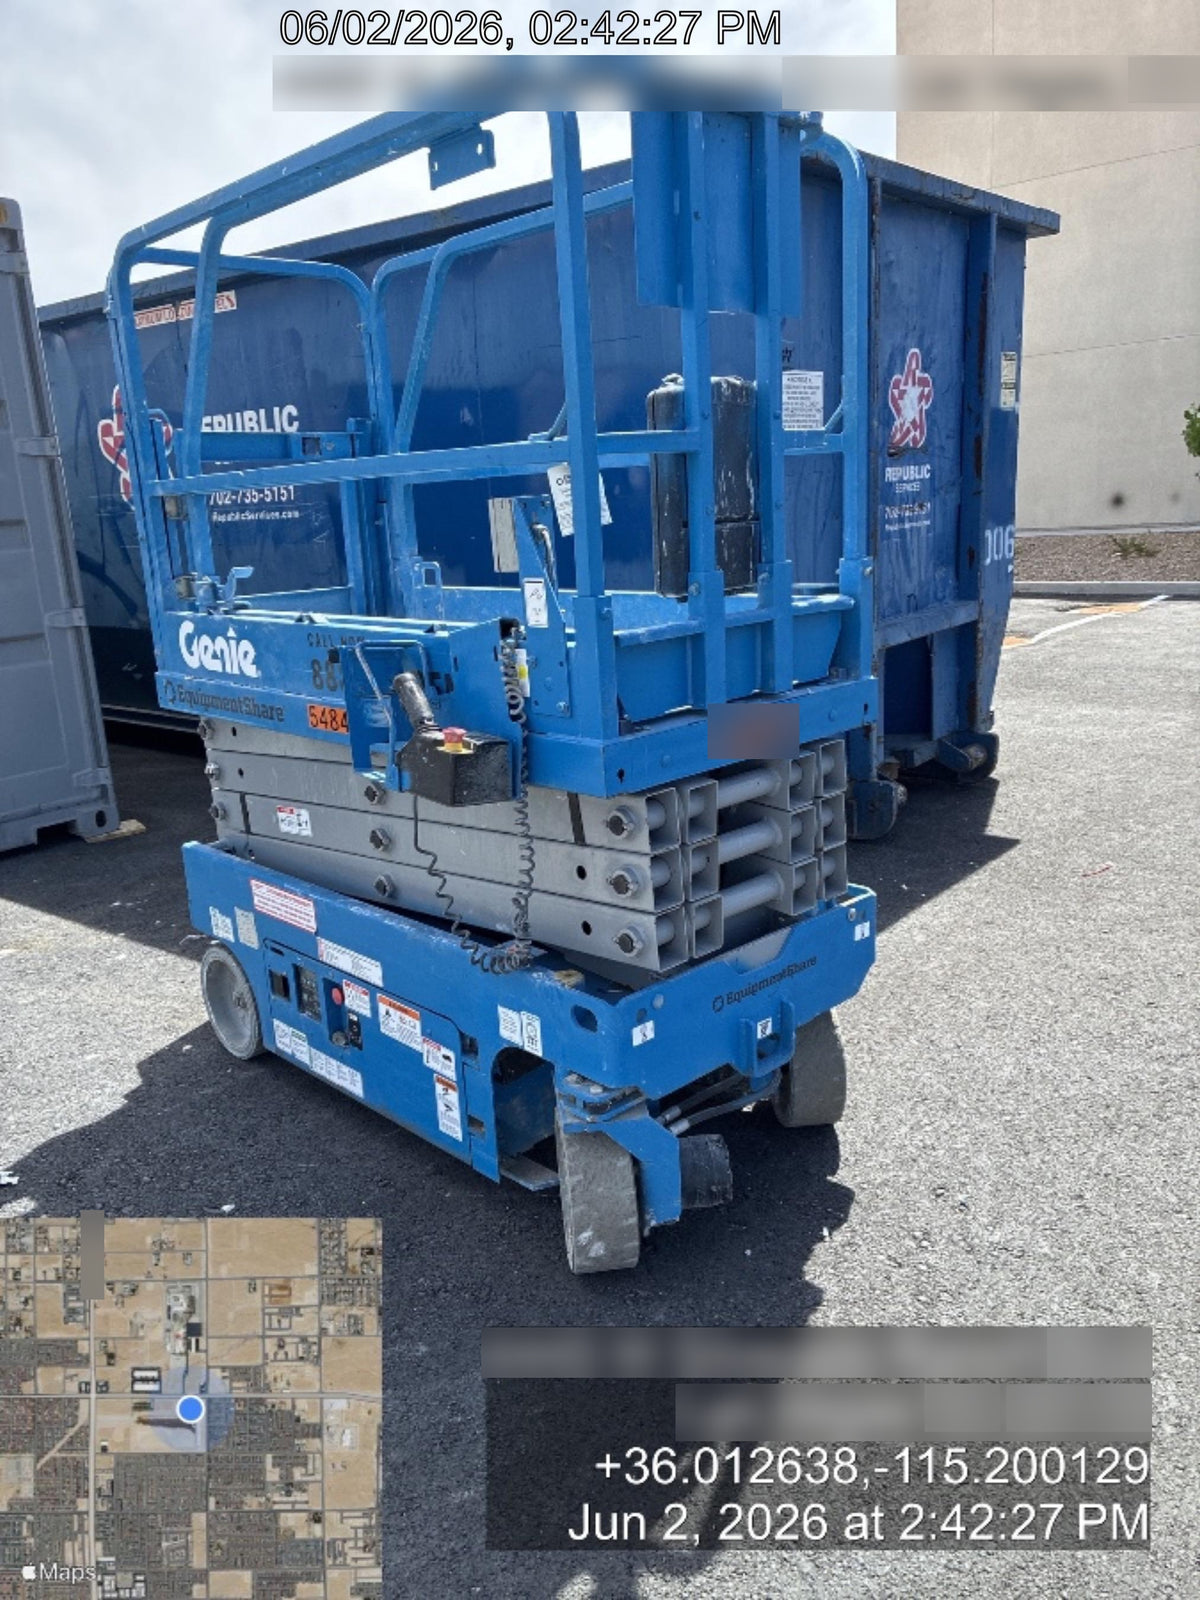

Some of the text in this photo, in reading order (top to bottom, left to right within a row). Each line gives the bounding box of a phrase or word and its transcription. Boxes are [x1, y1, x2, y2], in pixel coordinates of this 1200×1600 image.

[201, 404, 299, 433] EPUBLIC
[884, 464, 931, 482] REPUBLIC
[209, 485, 295, 506] 702-735-5151
[178, 620, 259, 678] Genie
[306, 632, 335, 648] CALL
[310, 657, 345, 693] 88
[177, 684, 285, 722] EquipmentShare
[726, 956, 818, 1001] EquipmentShare
